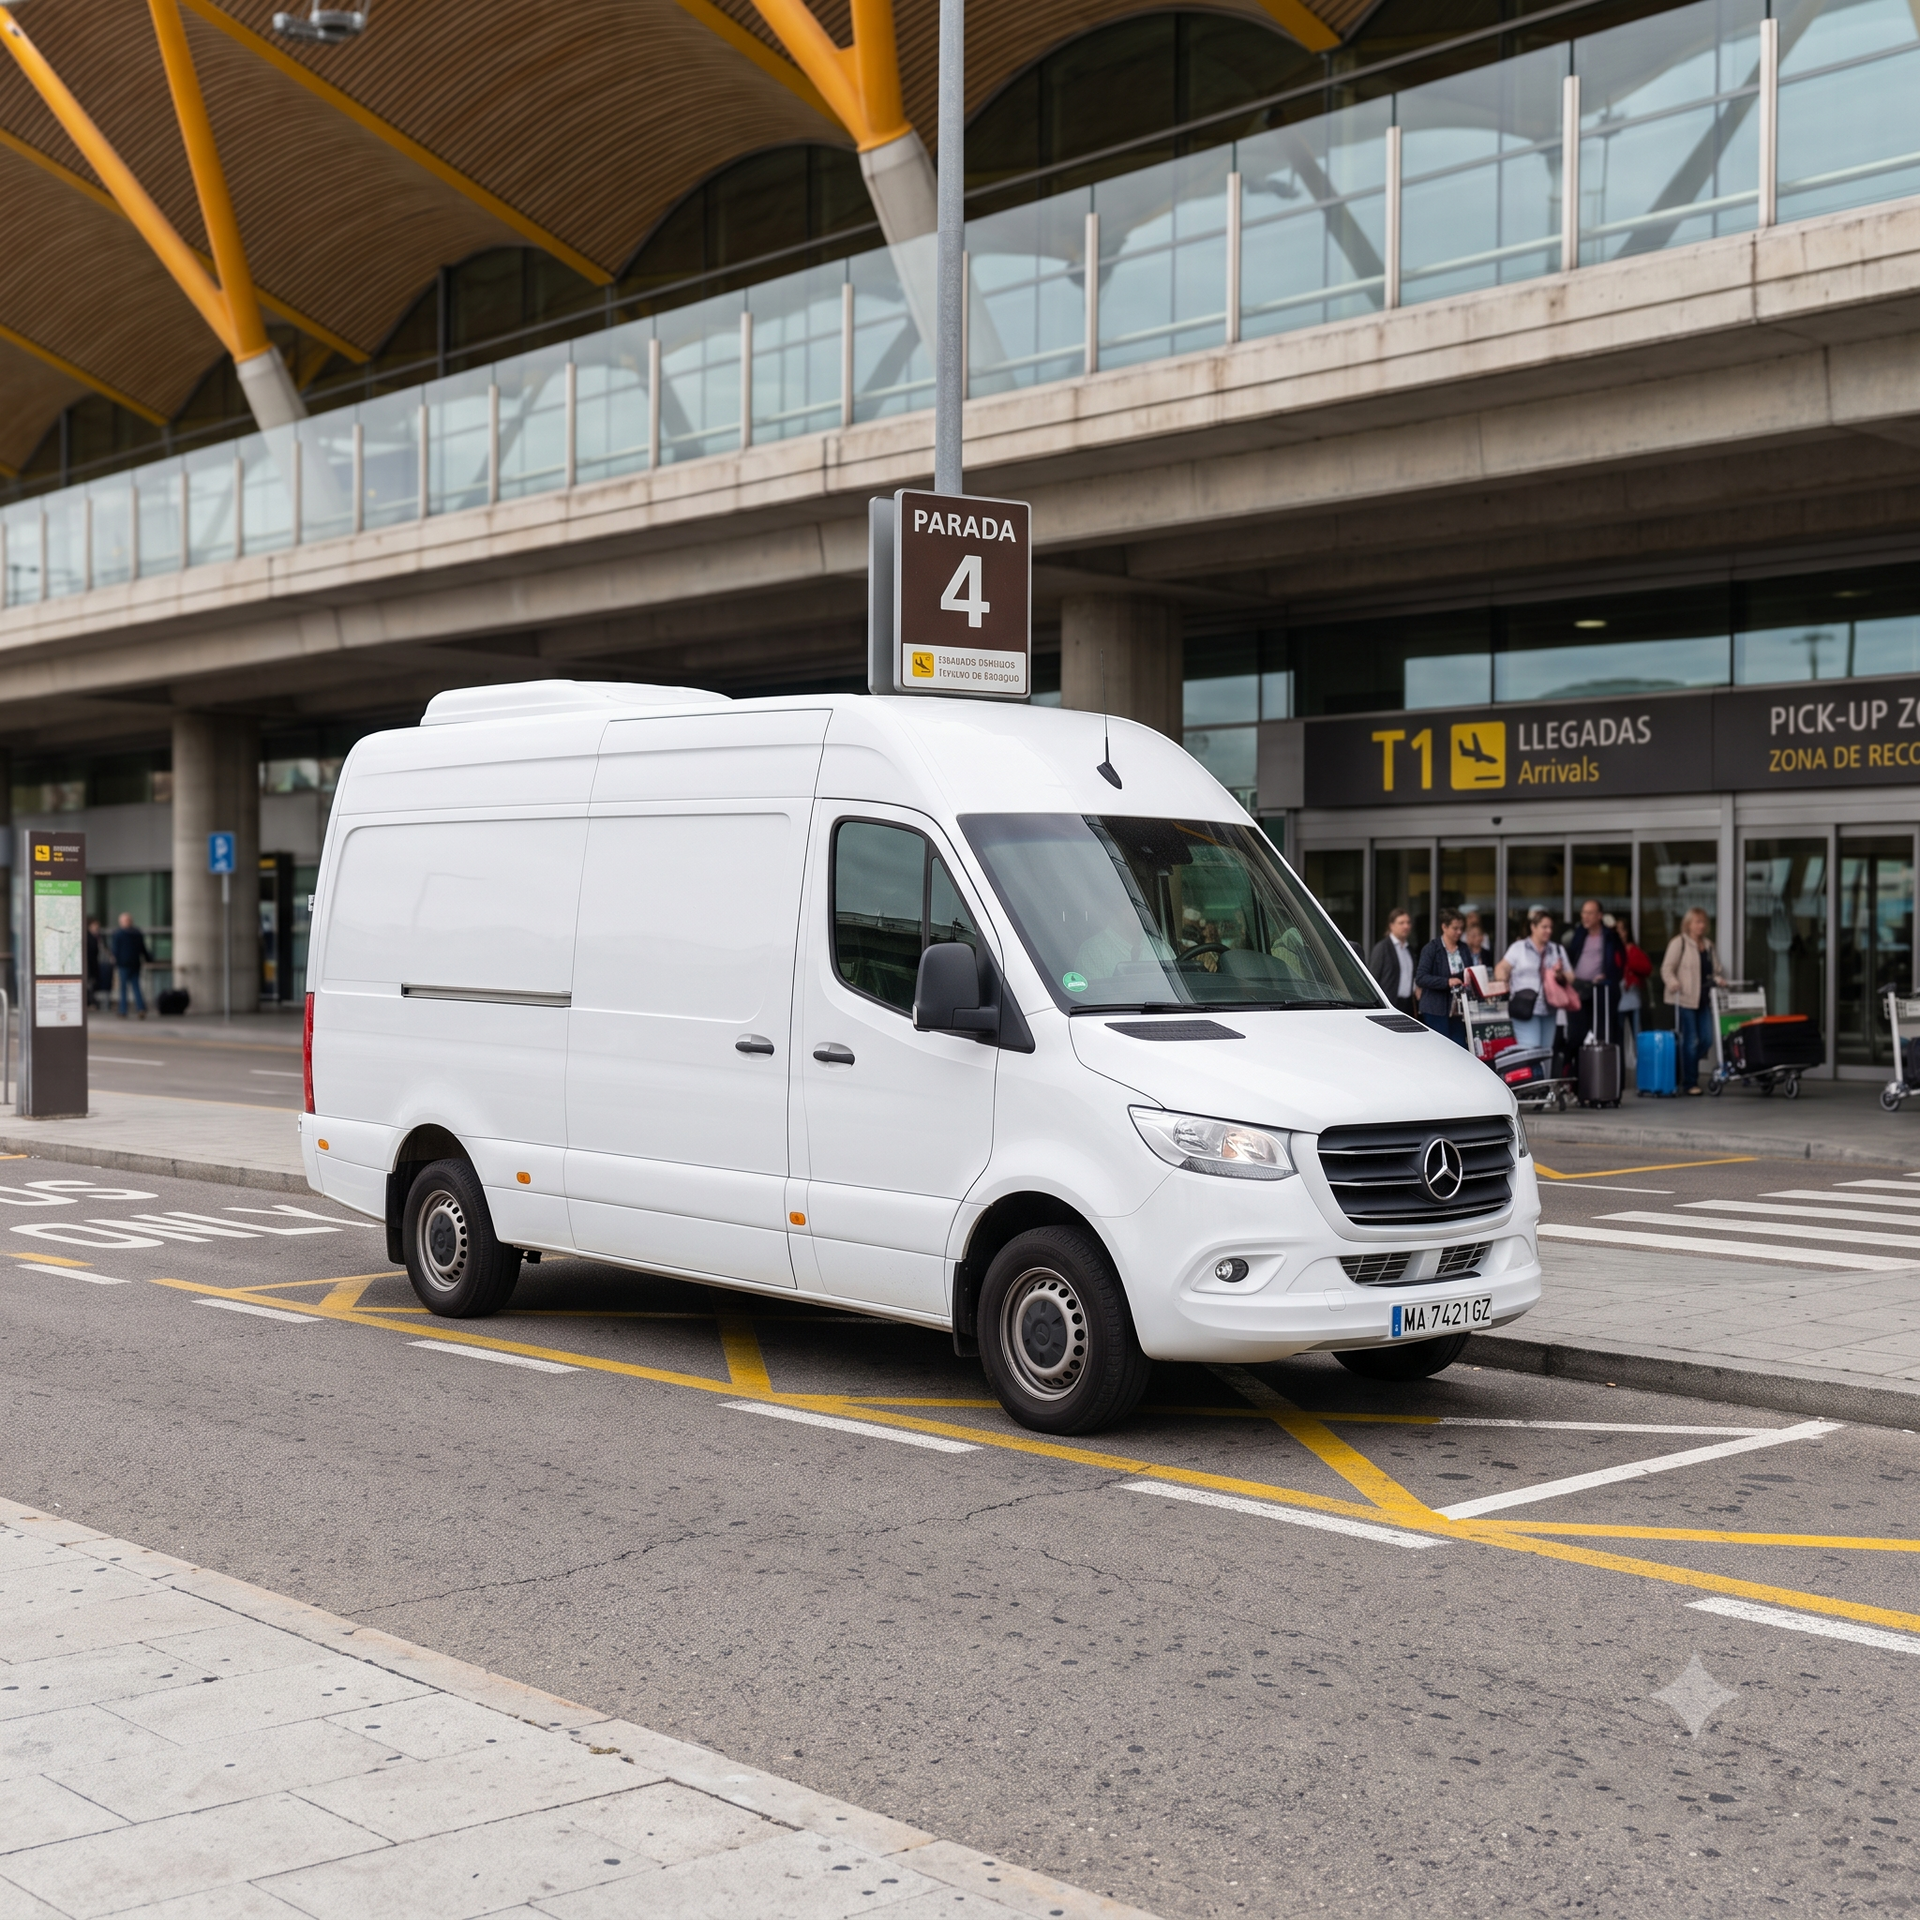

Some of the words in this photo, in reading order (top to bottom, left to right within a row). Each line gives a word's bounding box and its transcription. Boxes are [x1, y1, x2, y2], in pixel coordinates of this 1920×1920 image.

[914, 509, 1017, 543] PARADA
[940, 555, 990, 628] 4
[1518, 715, 1651, 751] LLEGADAS
[1770, 700, 1888, 736] PICK-UP
[1898, 698, 1920, 729] Z
[1371, 728, 1432, 791] T1
[1518, 755, 1600, 785] Arrivals
[1769, 747, 1828, 772] ZONA
[1834, 745, 1861, 769] DE
[9, 1204, 383, 1249] ONLY
[1404, 1307, 1426, 1332] MA
